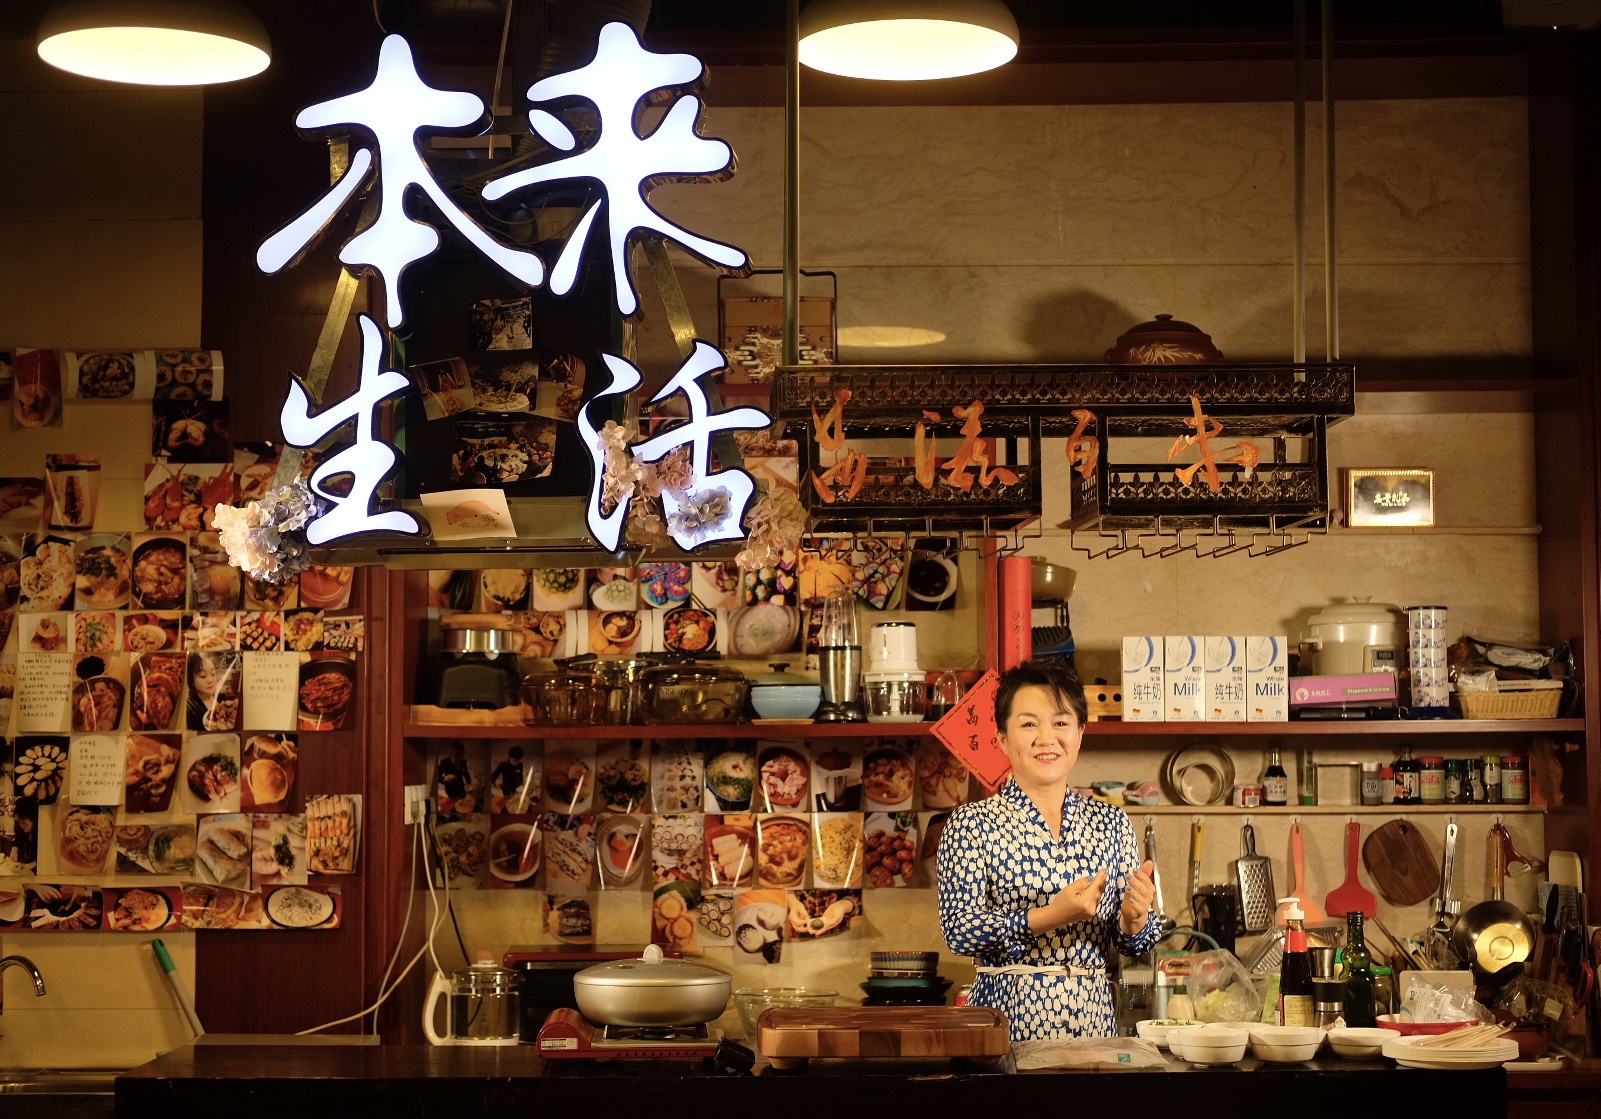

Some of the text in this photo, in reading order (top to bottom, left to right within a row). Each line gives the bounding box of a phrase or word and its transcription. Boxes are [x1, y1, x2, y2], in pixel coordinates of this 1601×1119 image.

[254, 20, 749, 330] 本来
[278, 312, 773, 554] 生活
[1133, 682, 1162, 701] 纯牛奶
[1173, 683, 1201, 696] Milk
[1214, 682, 1244, 701] 纯牛奶
[1255, 683, 1285, 696] Milk
